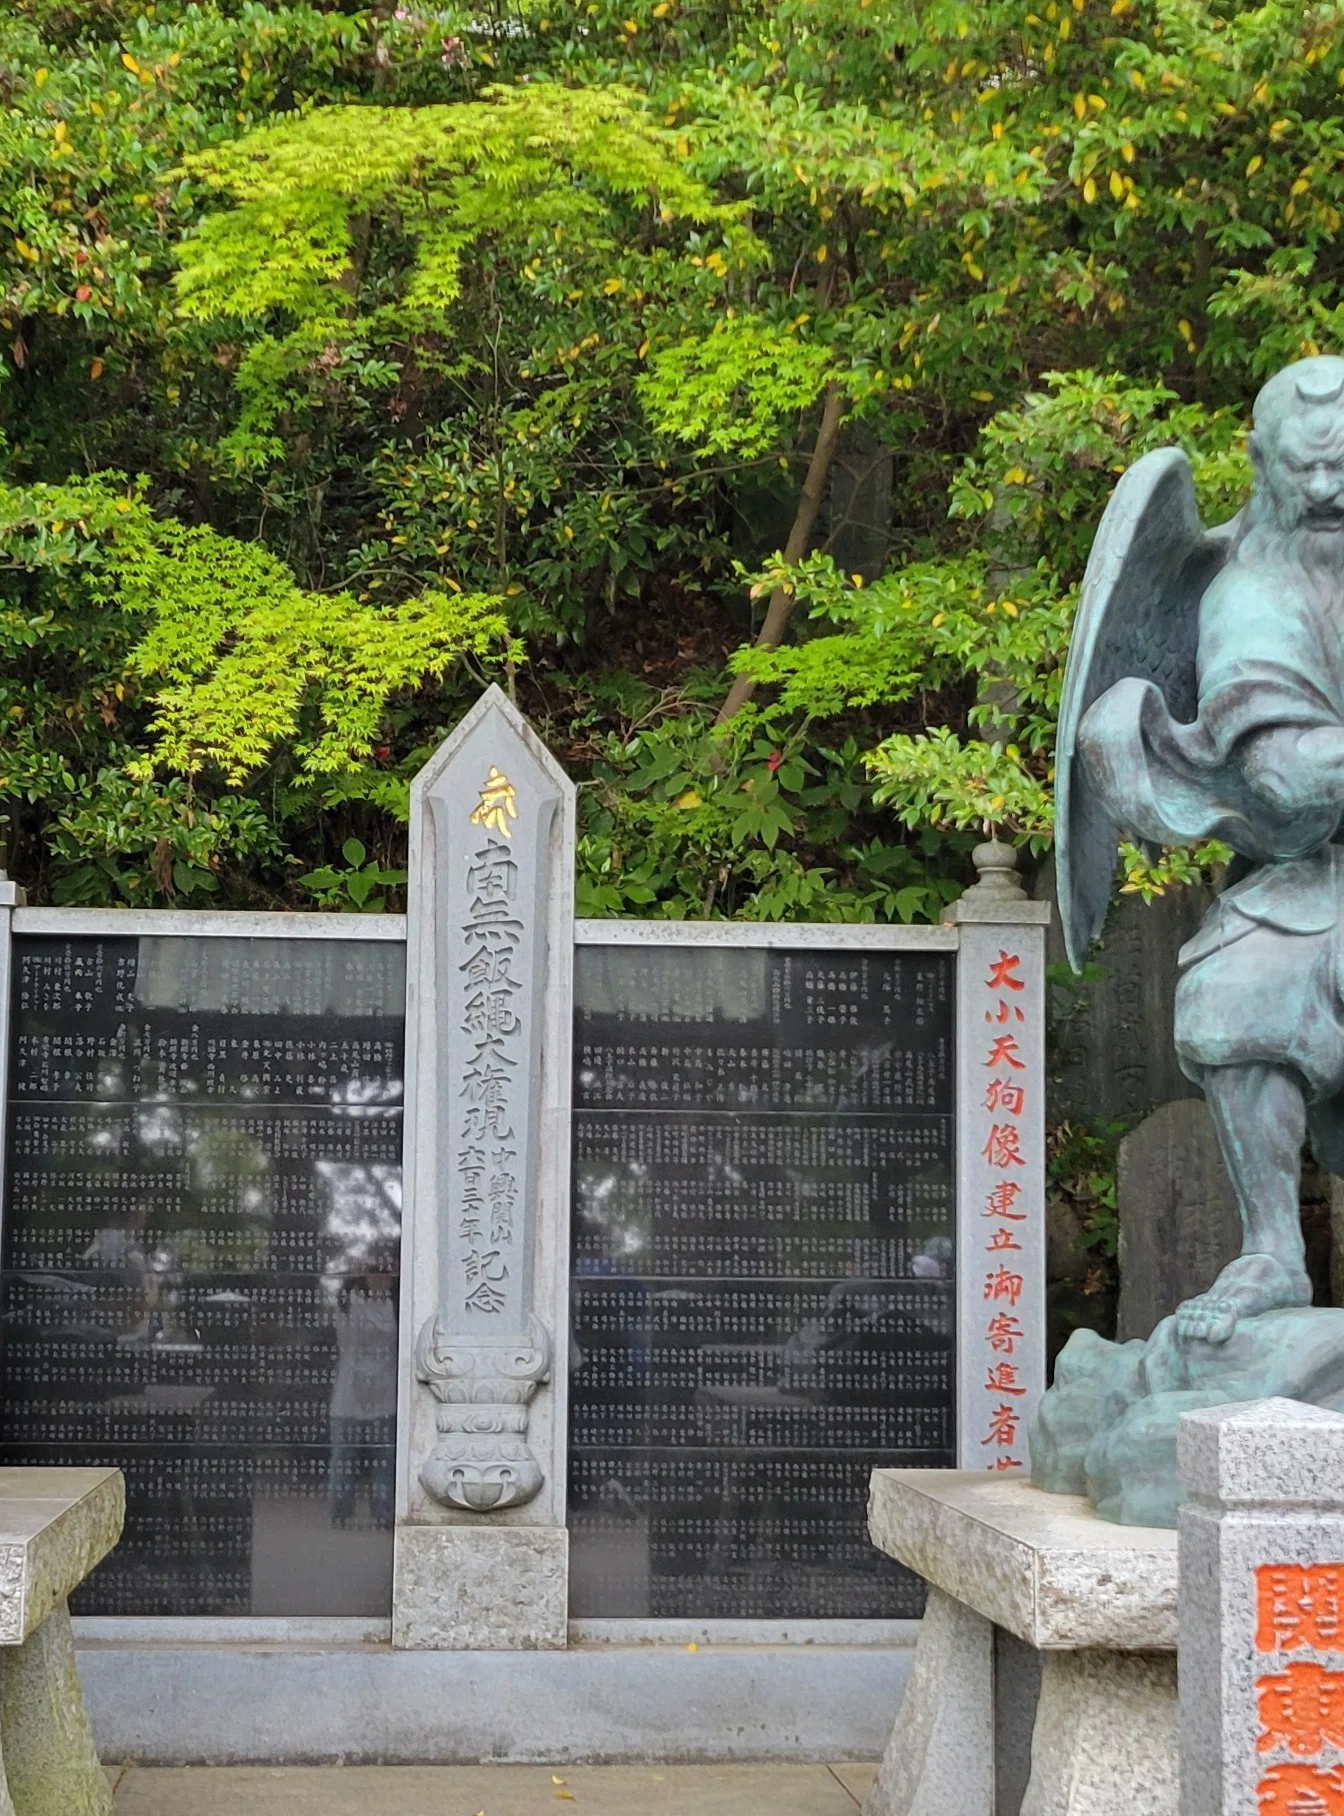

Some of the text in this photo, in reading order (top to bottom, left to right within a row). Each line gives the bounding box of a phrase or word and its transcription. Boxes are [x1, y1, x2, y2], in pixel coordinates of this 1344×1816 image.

[458, 838, 525, 1142] 南無飯縄大権現
[457, 1145, 486, 1246] 六百三十年
[488, 1146, 520, 1246] 中興開山
[461, 1248, 511, 1314] 記念
